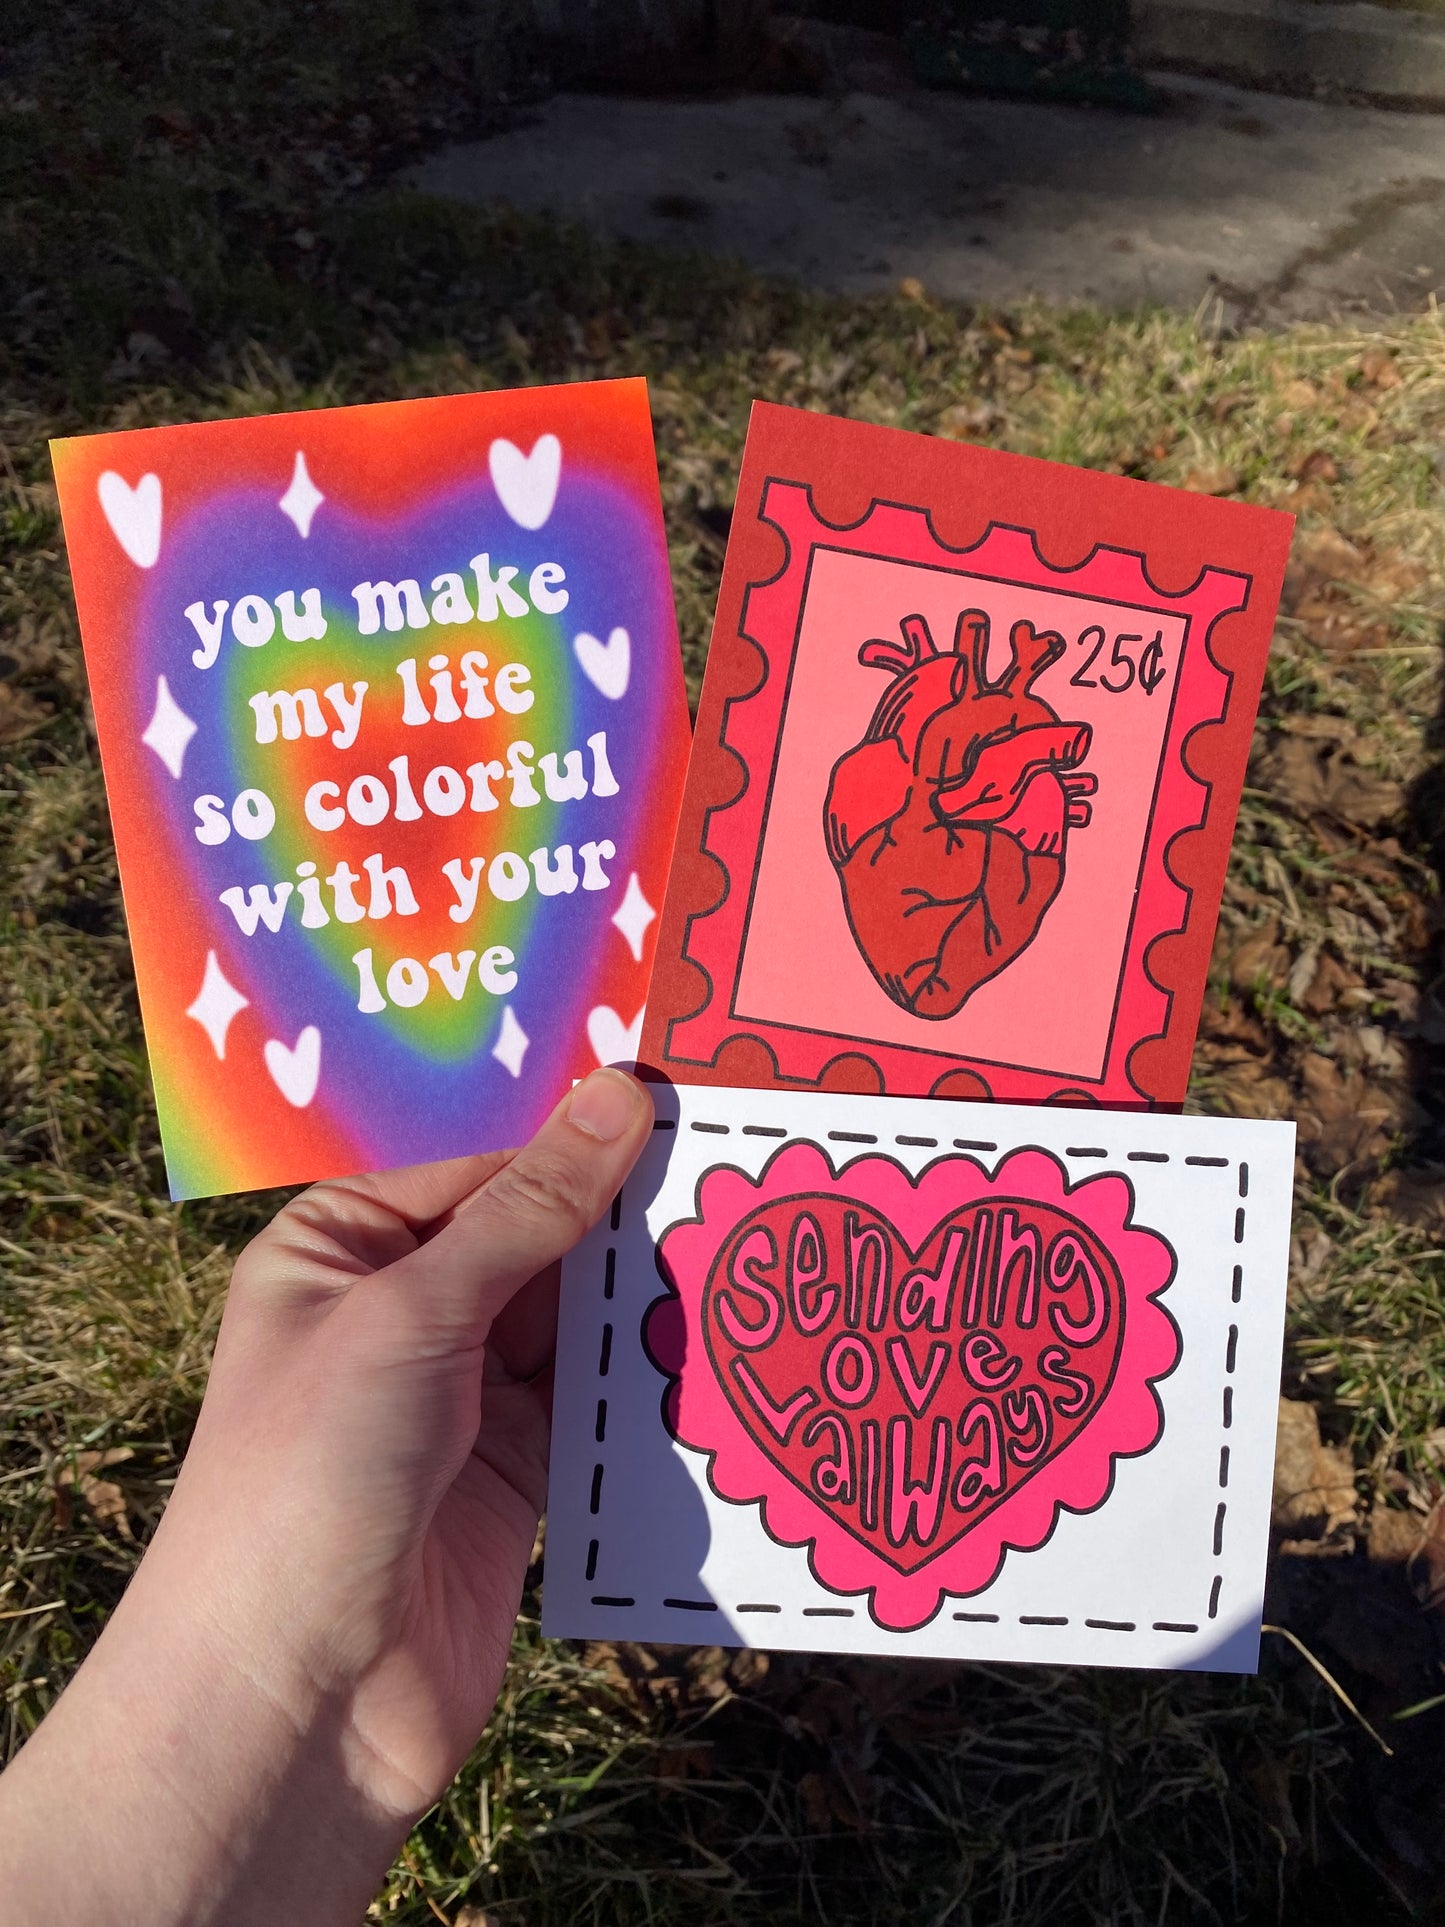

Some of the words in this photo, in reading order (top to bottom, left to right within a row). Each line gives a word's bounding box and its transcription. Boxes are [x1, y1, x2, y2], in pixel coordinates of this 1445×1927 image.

[183, 587, 328, 670] you
[351, 552, 570, 635] make
[1069, 624, 1167, 696] 25¢
[248, 680, 369, 749] my
[396, 650, 536, 726] life
[192, 787, 276, 846] so
[303, 731, 621, 832] colorful
[218, 852, 421, 937] with
[441, 838, 617, 924] your
[351, 945, 519, 1014] love
